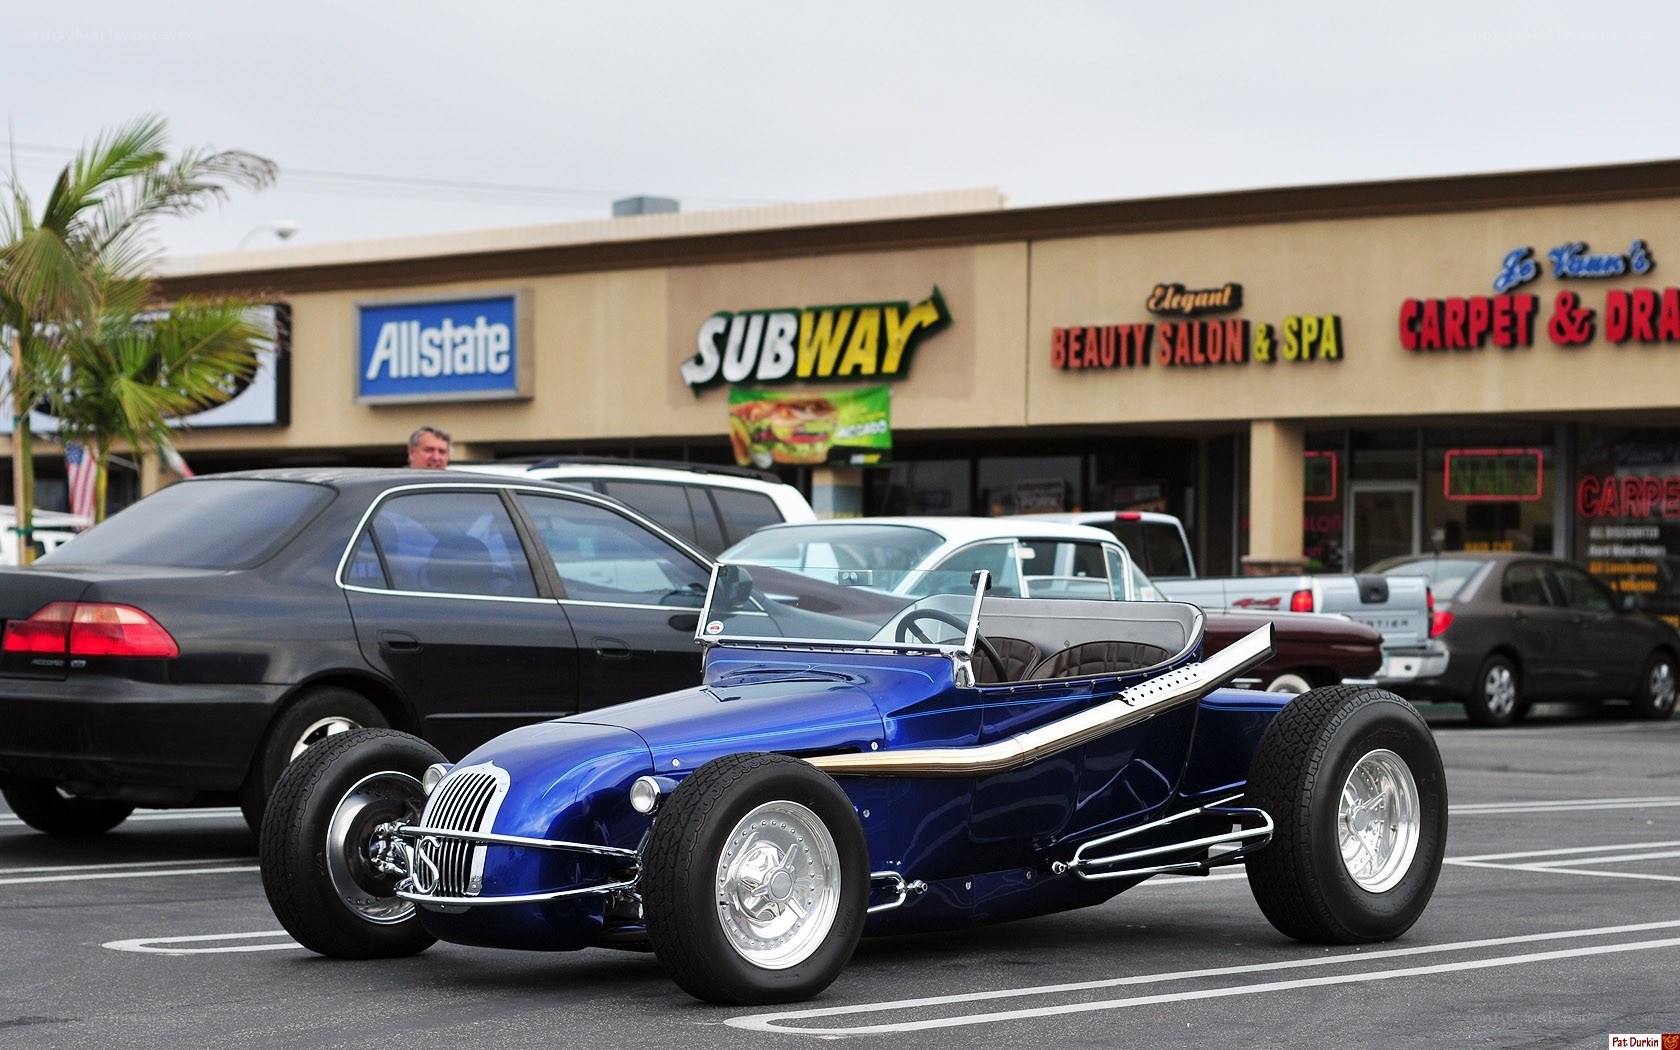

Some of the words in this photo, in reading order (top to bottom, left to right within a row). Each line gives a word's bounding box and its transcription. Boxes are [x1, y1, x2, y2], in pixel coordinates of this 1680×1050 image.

[1148, 283, 1240, 314] Elegant
[1399, 293, 1535, 350] CARPET
[1548, 290, 1594, 344] &
[365, 315, 511, 381] Allstate
[680, 299, 940, 386] SUBWAY
[1051, 323, 1149, 369] BEAUTY
[1157, 319, 1245, 366] SALON
[1254, 322, 1273, 363] &
[1282, 313, 1340, 361] SPA
